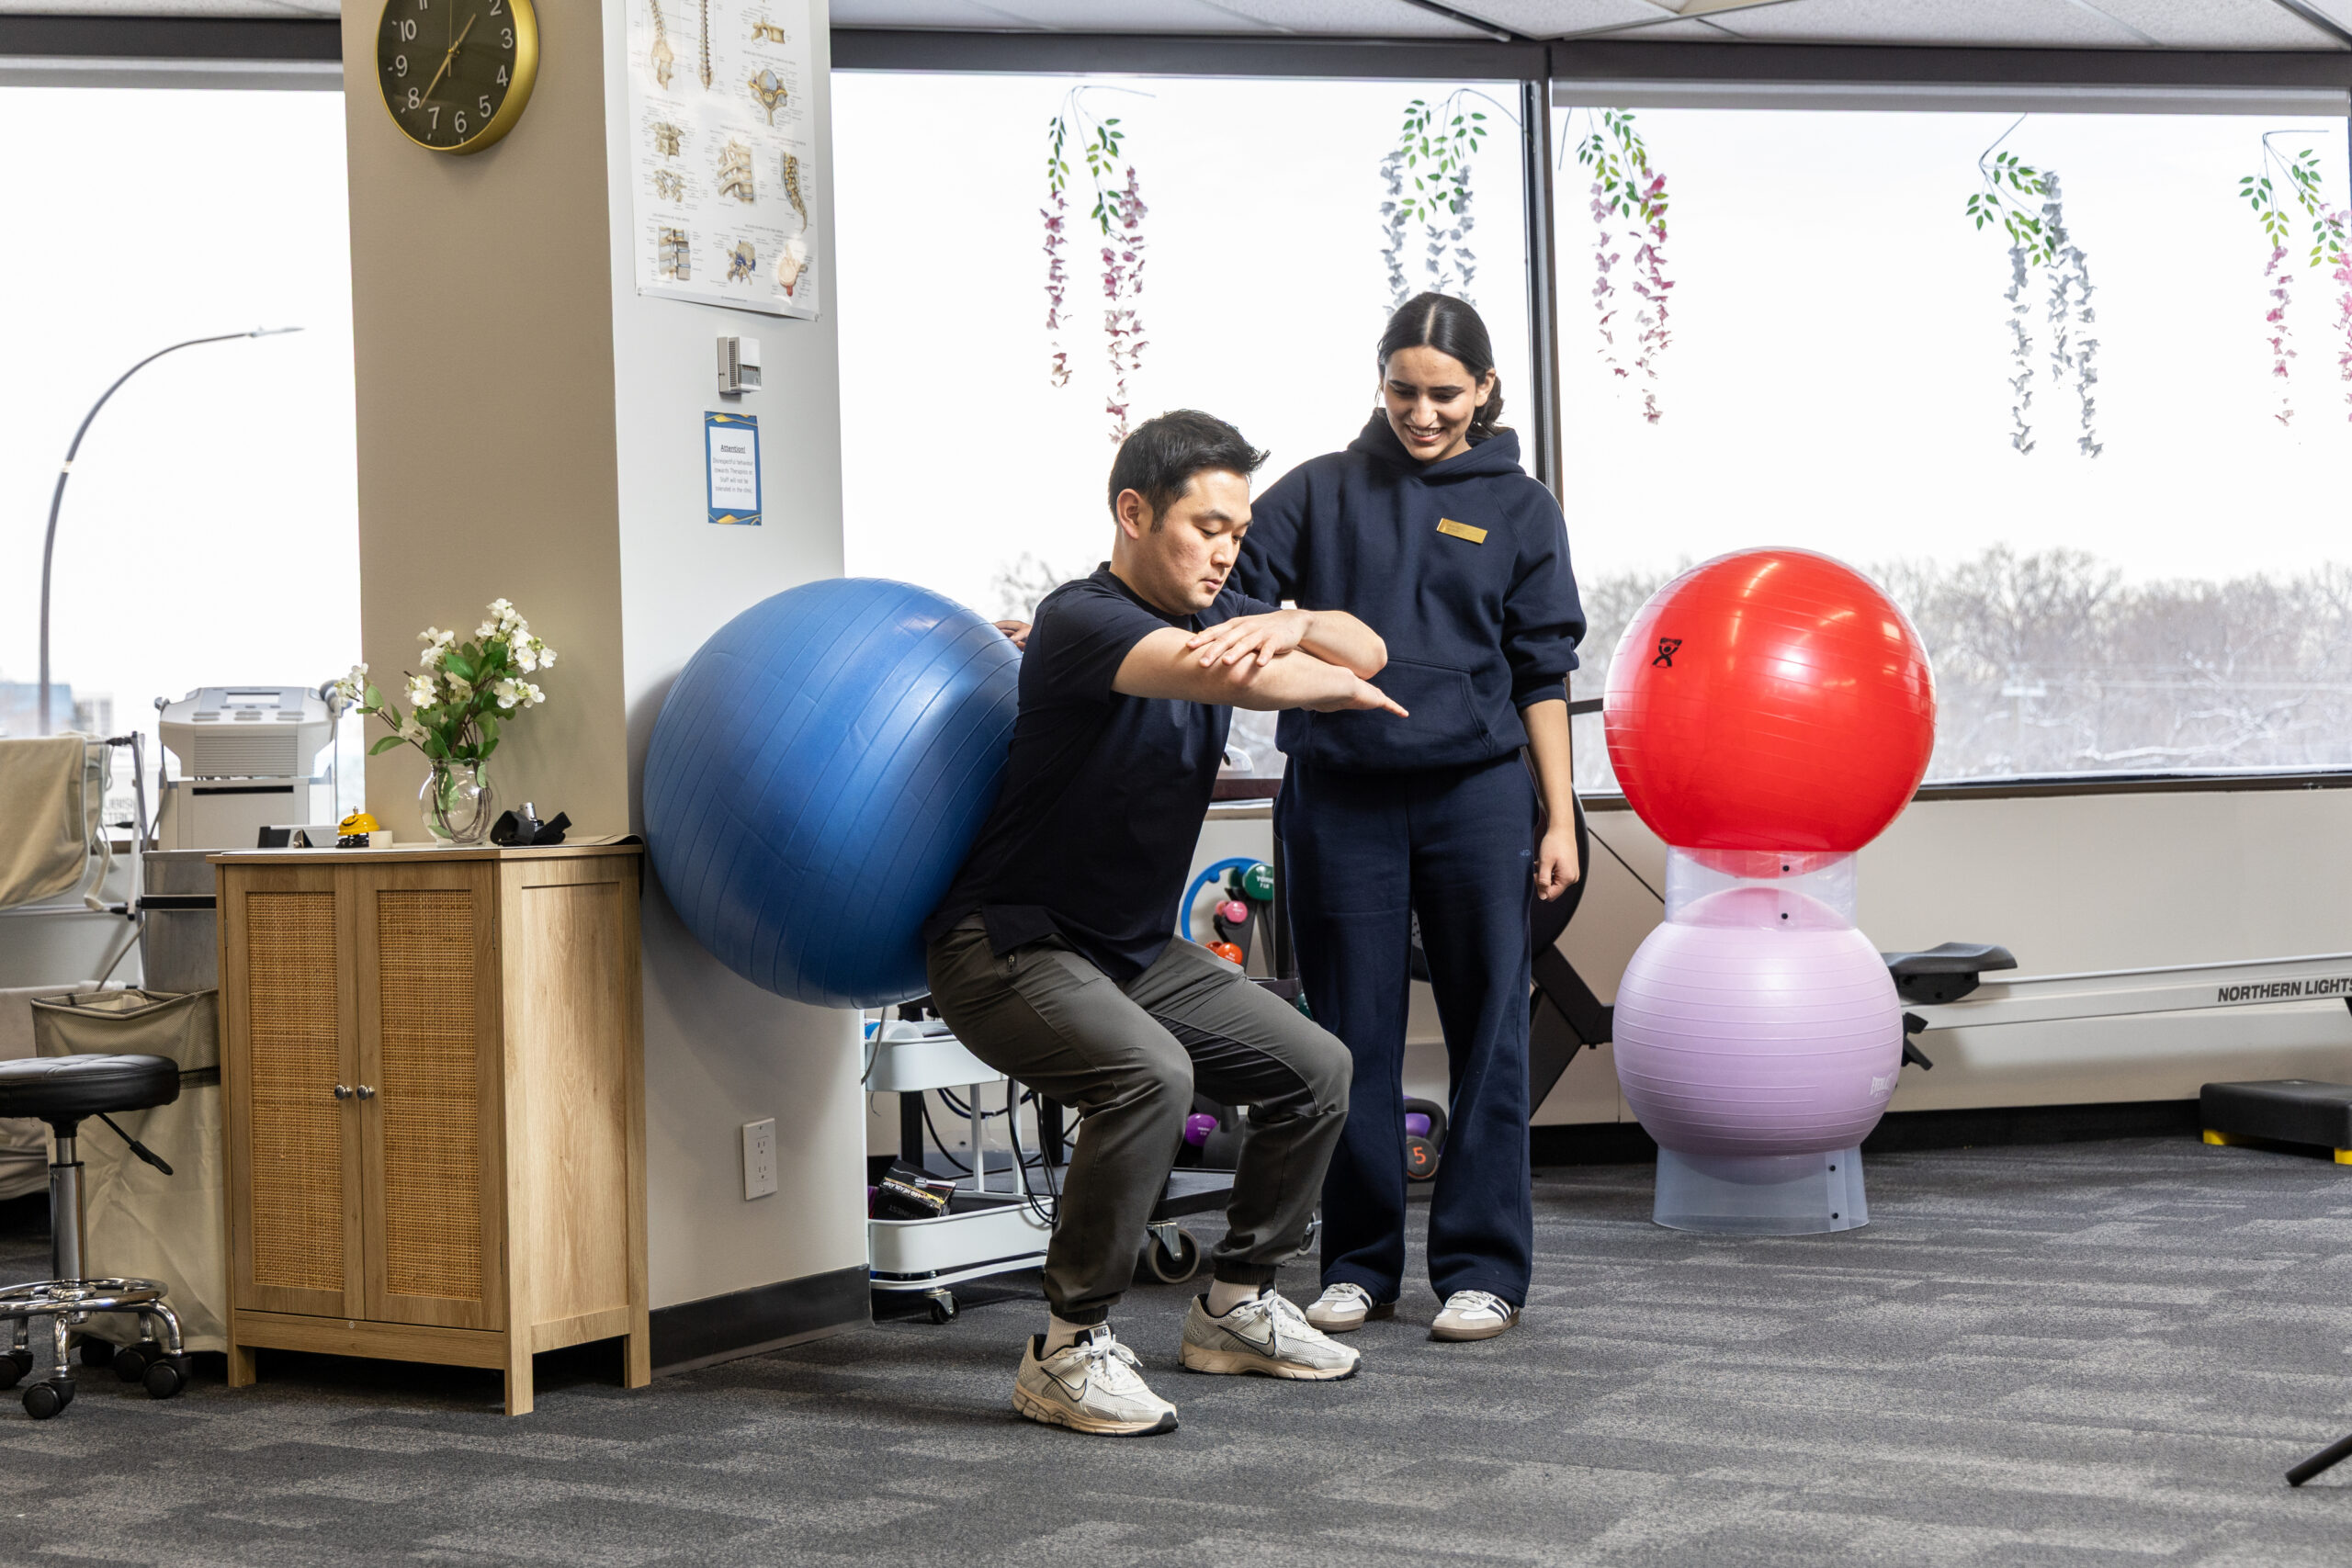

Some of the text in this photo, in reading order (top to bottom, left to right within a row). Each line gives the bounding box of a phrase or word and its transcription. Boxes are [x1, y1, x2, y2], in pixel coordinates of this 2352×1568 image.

[489, 0, 503, 17] 2
[401, 19, 417, 42] 10
[501, 28, 514, 49] 3
[395, 55, 408, 77] 9
[496, 64, 509, 87] 4
[408, 87, 420, 109] 8
[479, 95, 492, 118] 5
[427, 107, 440, 130] 7
[455, 110, 467, 133] 6
[2217, 982, 2301, 1002] NORTHERN
[1412, 1146, 1426, 1164] 5
[1094, 1327, 1107, 1338] NIKE
